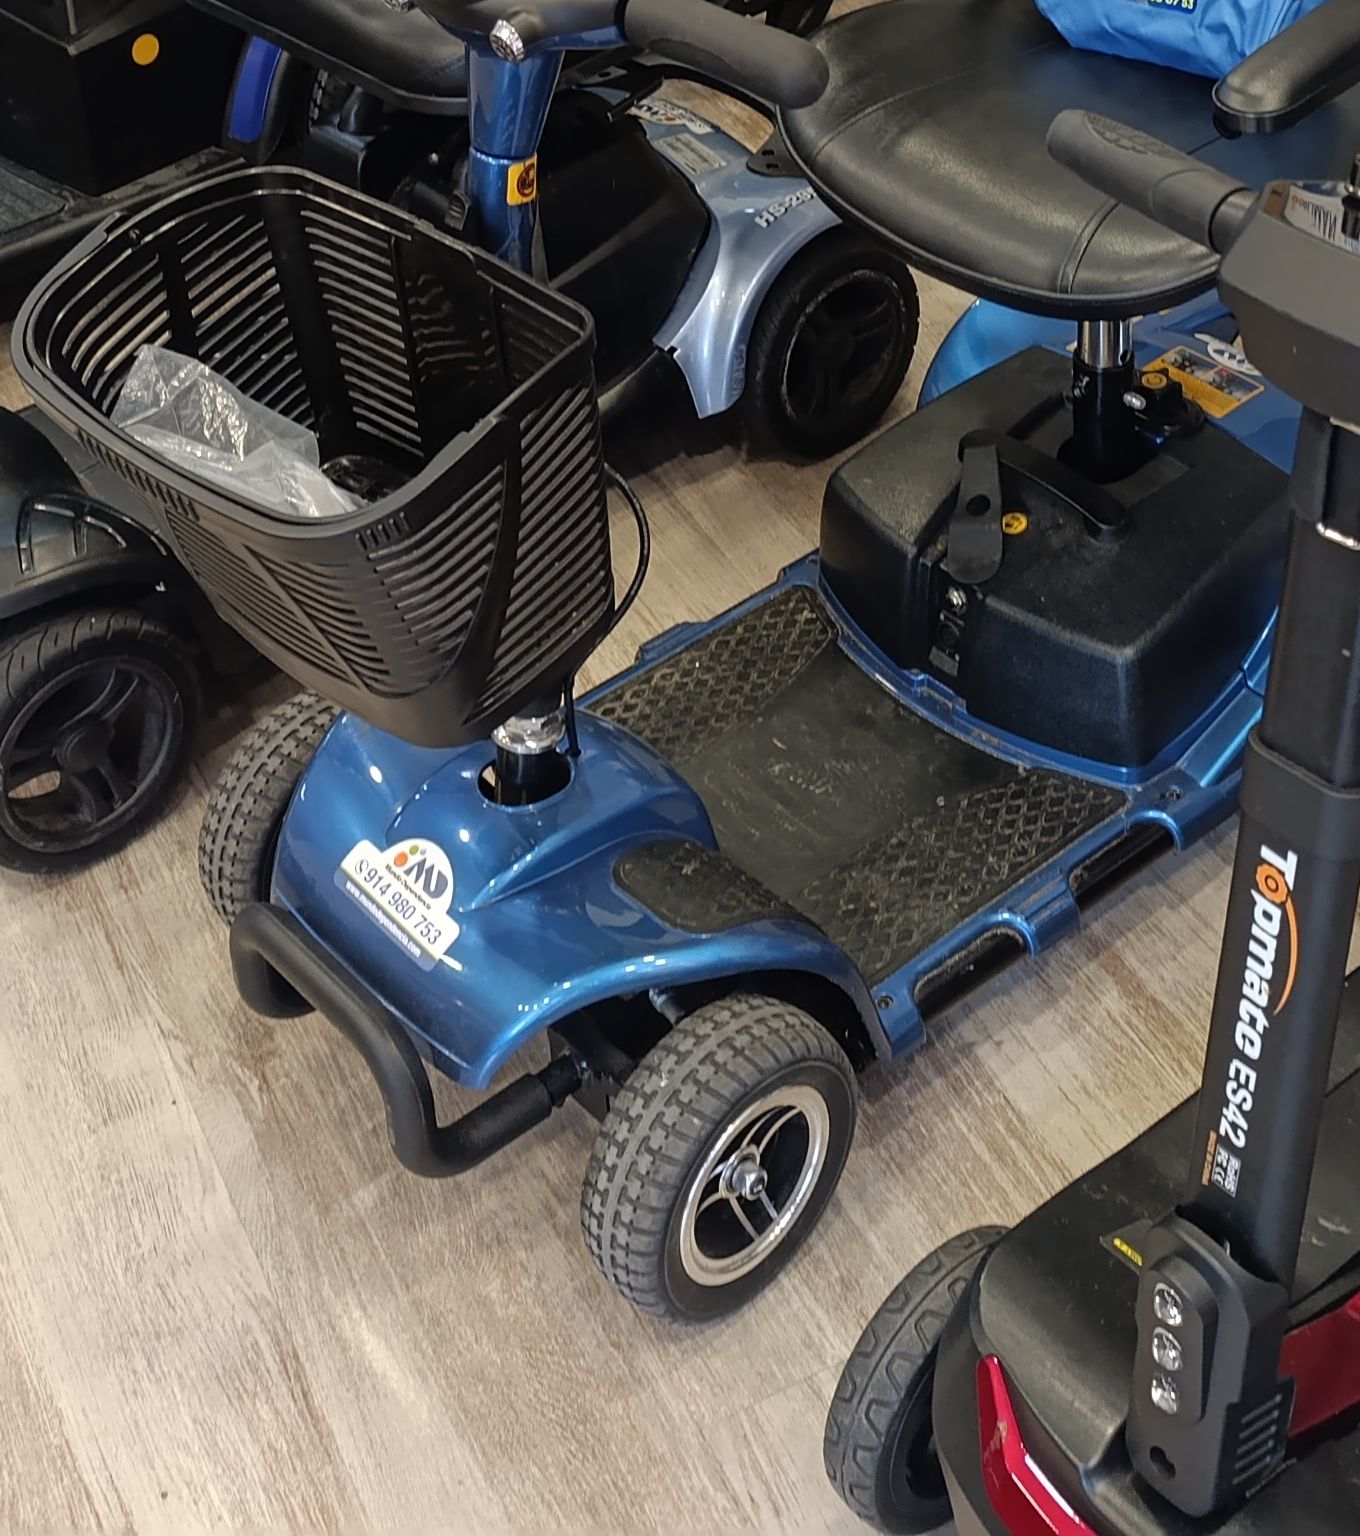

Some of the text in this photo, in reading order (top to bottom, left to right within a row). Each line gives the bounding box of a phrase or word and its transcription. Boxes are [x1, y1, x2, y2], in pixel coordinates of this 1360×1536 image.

[345, 879, 422, 959] www.mundodependencia.com
[363, 868, 443, 945] 914 980 753
[1218, 1056, 1257, 1149] ES42
